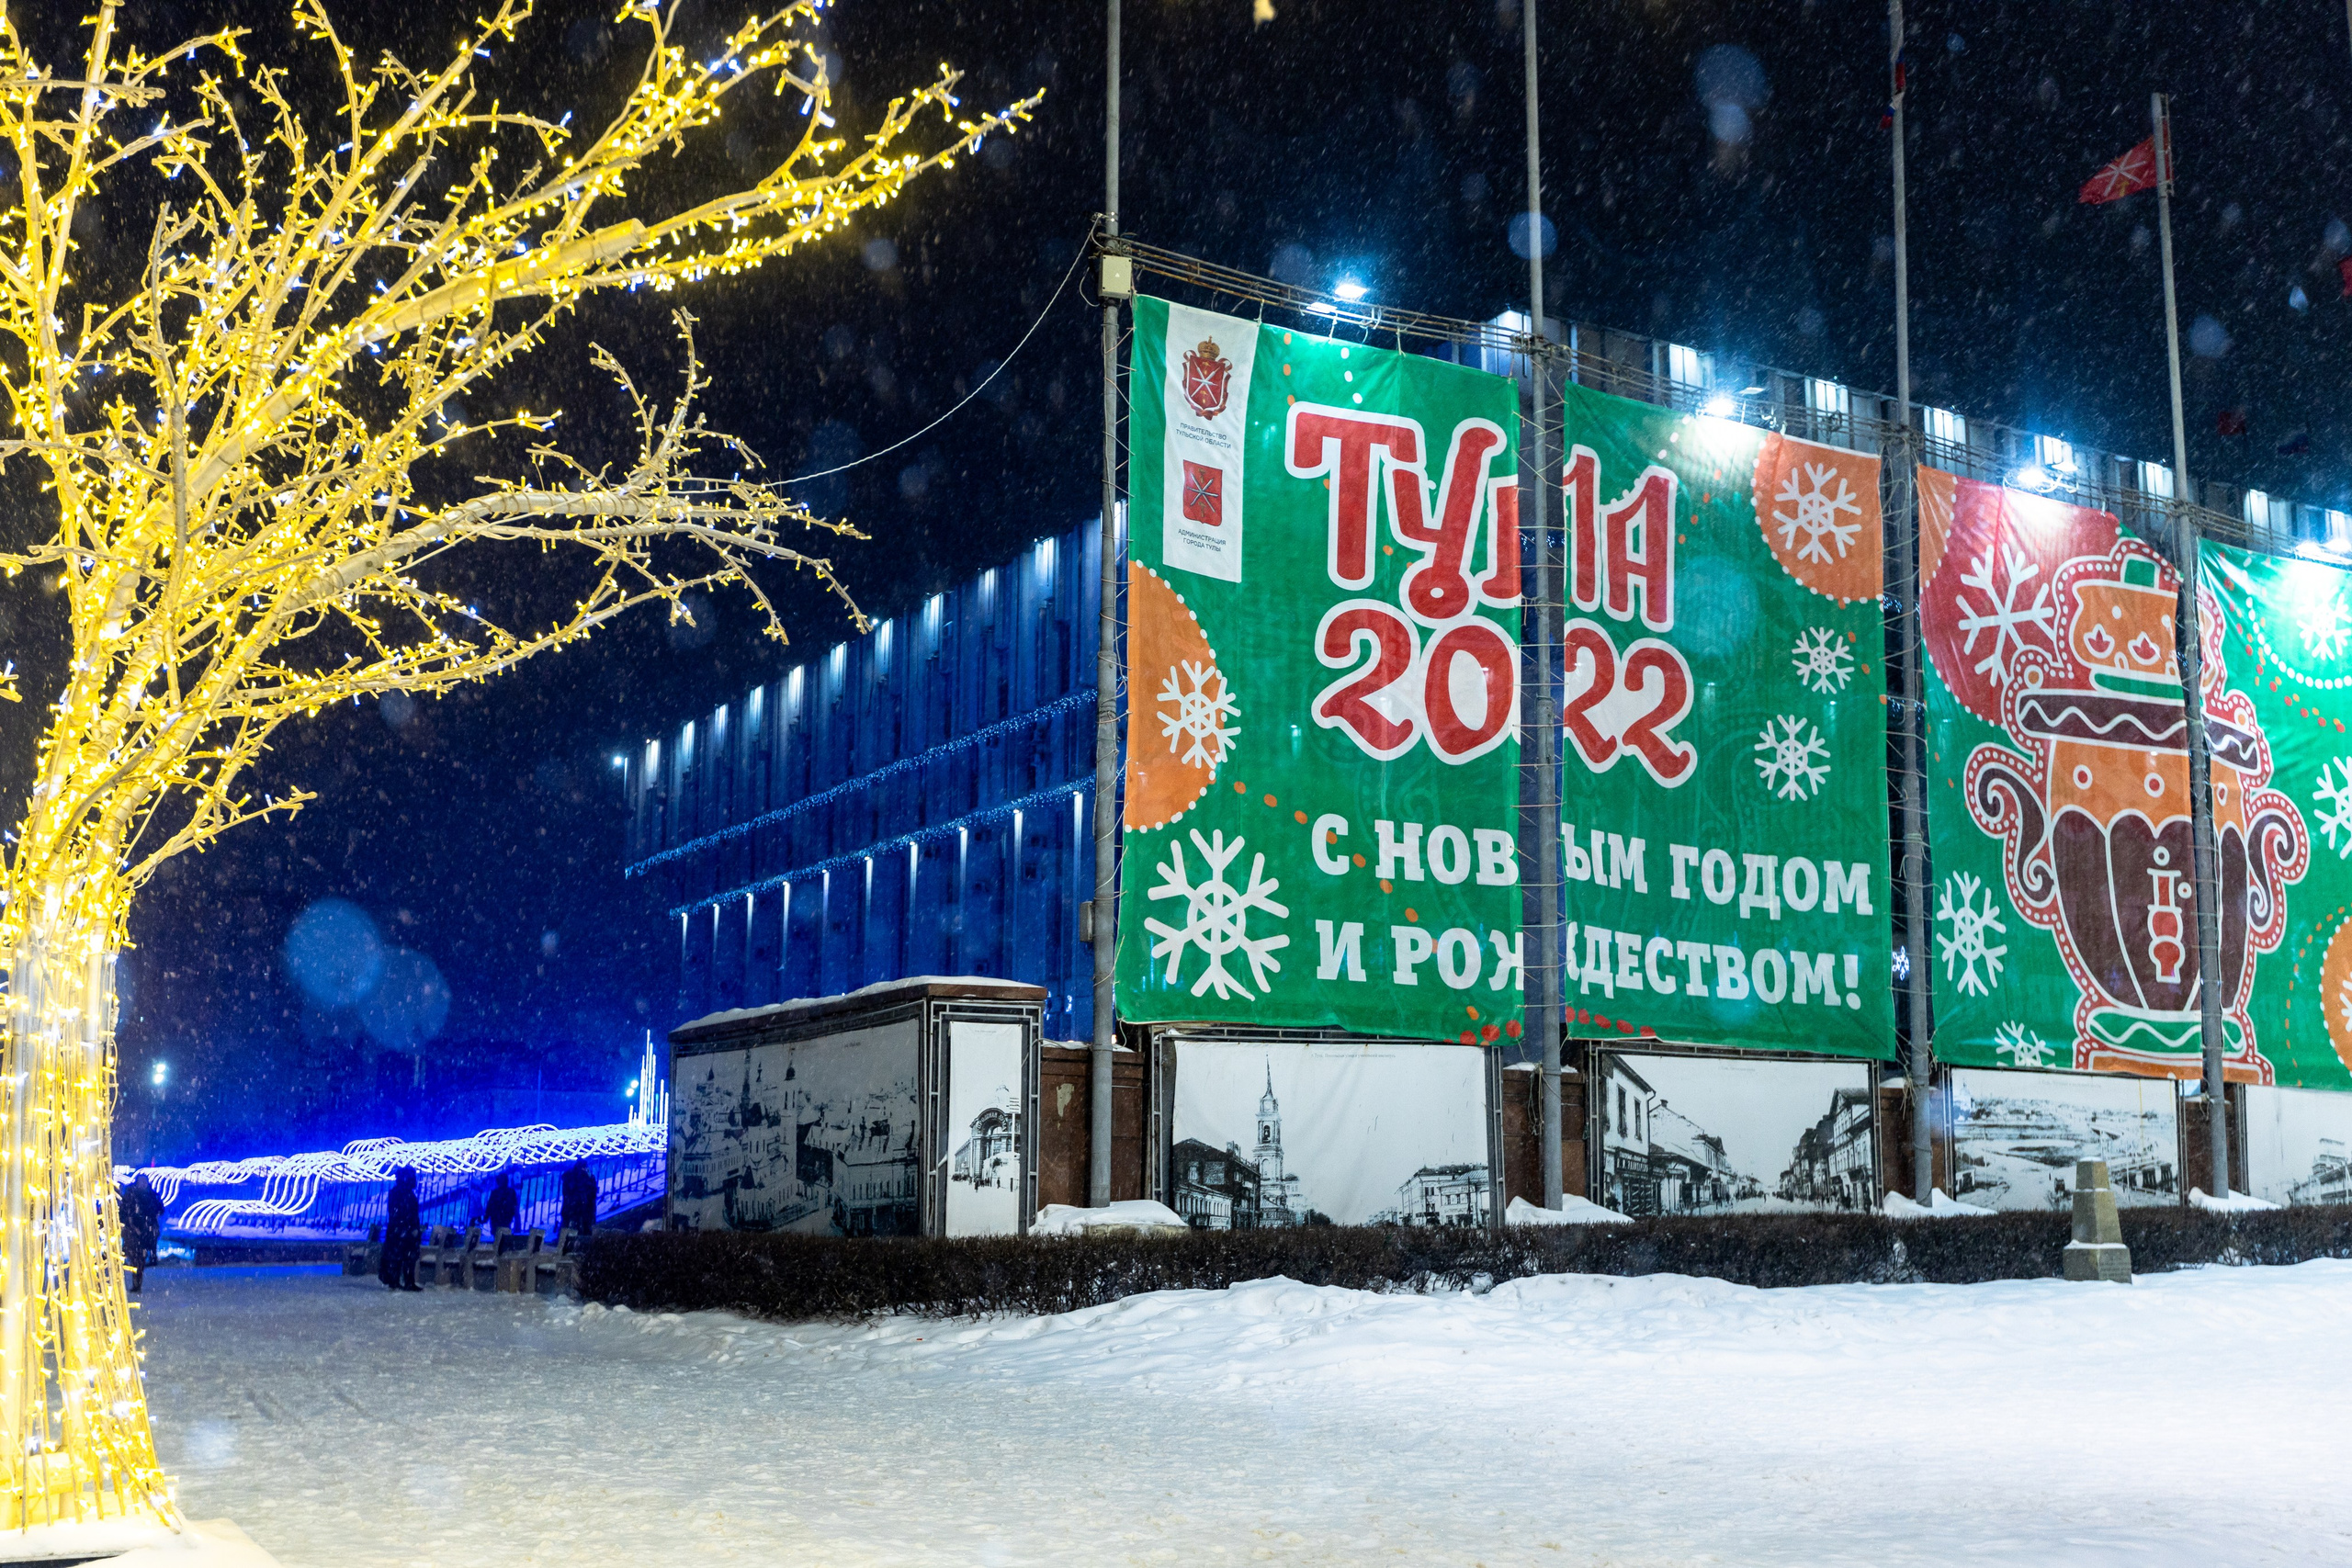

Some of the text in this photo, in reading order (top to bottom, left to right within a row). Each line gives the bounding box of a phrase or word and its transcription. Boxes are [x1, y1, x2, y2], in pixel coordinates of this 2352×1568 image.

[1176, 428, 1232, 449] ТУЛЬСКОЙ ОБЛАСТИ
[1180, 423, 1227, 440] ПРАВИТЕЛЬСТВО
[1178, 528, 1227, 546] АДМИНИСТРАЦИЯ
[1284, 400, 1678, 632] ТУЛА
[1182, 537, 1222, 552] ГОРОДА ТУЛЫ
[1311, 598, 1698, 788] 2022
[1311, 813, 1873, 920] С НОВЫМ ГОДОМ
[1315, 919, 1862, 1010] И РОЖДЕСТВОМ!
